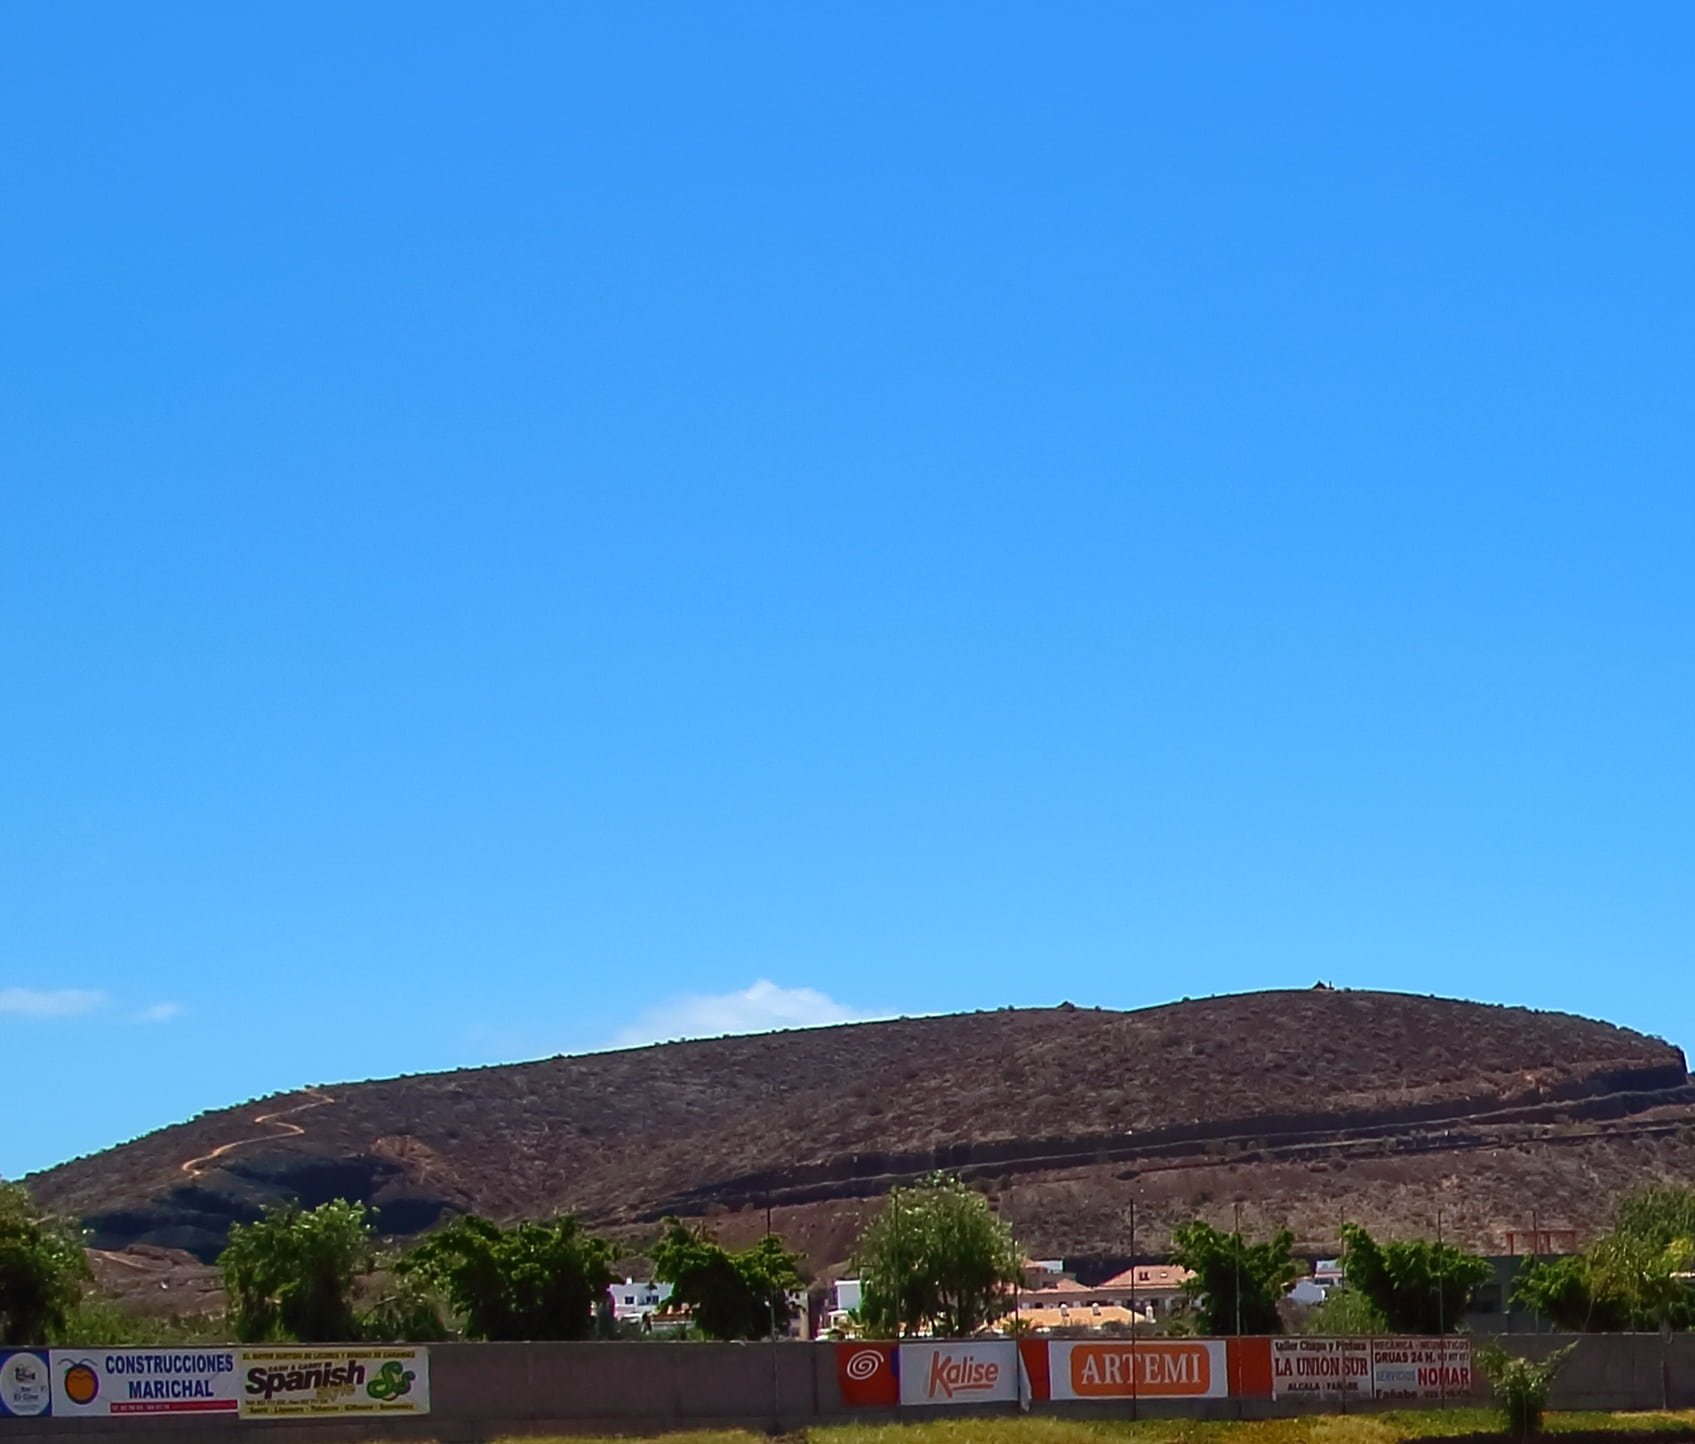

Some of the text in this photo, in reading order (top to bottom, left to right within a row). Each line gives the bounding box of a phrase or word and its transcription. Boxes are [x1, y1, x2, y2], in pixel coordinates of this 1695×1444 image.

[105, 1354, 234, 1375] CONSTRUCCIONES
[1275, 1357, 1293, 1376] LA
[1343, 1357, 1369, 1376] SUR
[1411, 1352, 1423, 1363] 24
[928, 1351, 998, 1398] Kalise
[1081, 1353, 1201, 1384] ARTEMI
[1418, 1367, 1470, 1386] NOMAR
[128, 1379, 215, 1399] MARICHAL
[245, 1360, 366, 1400] Spanish
